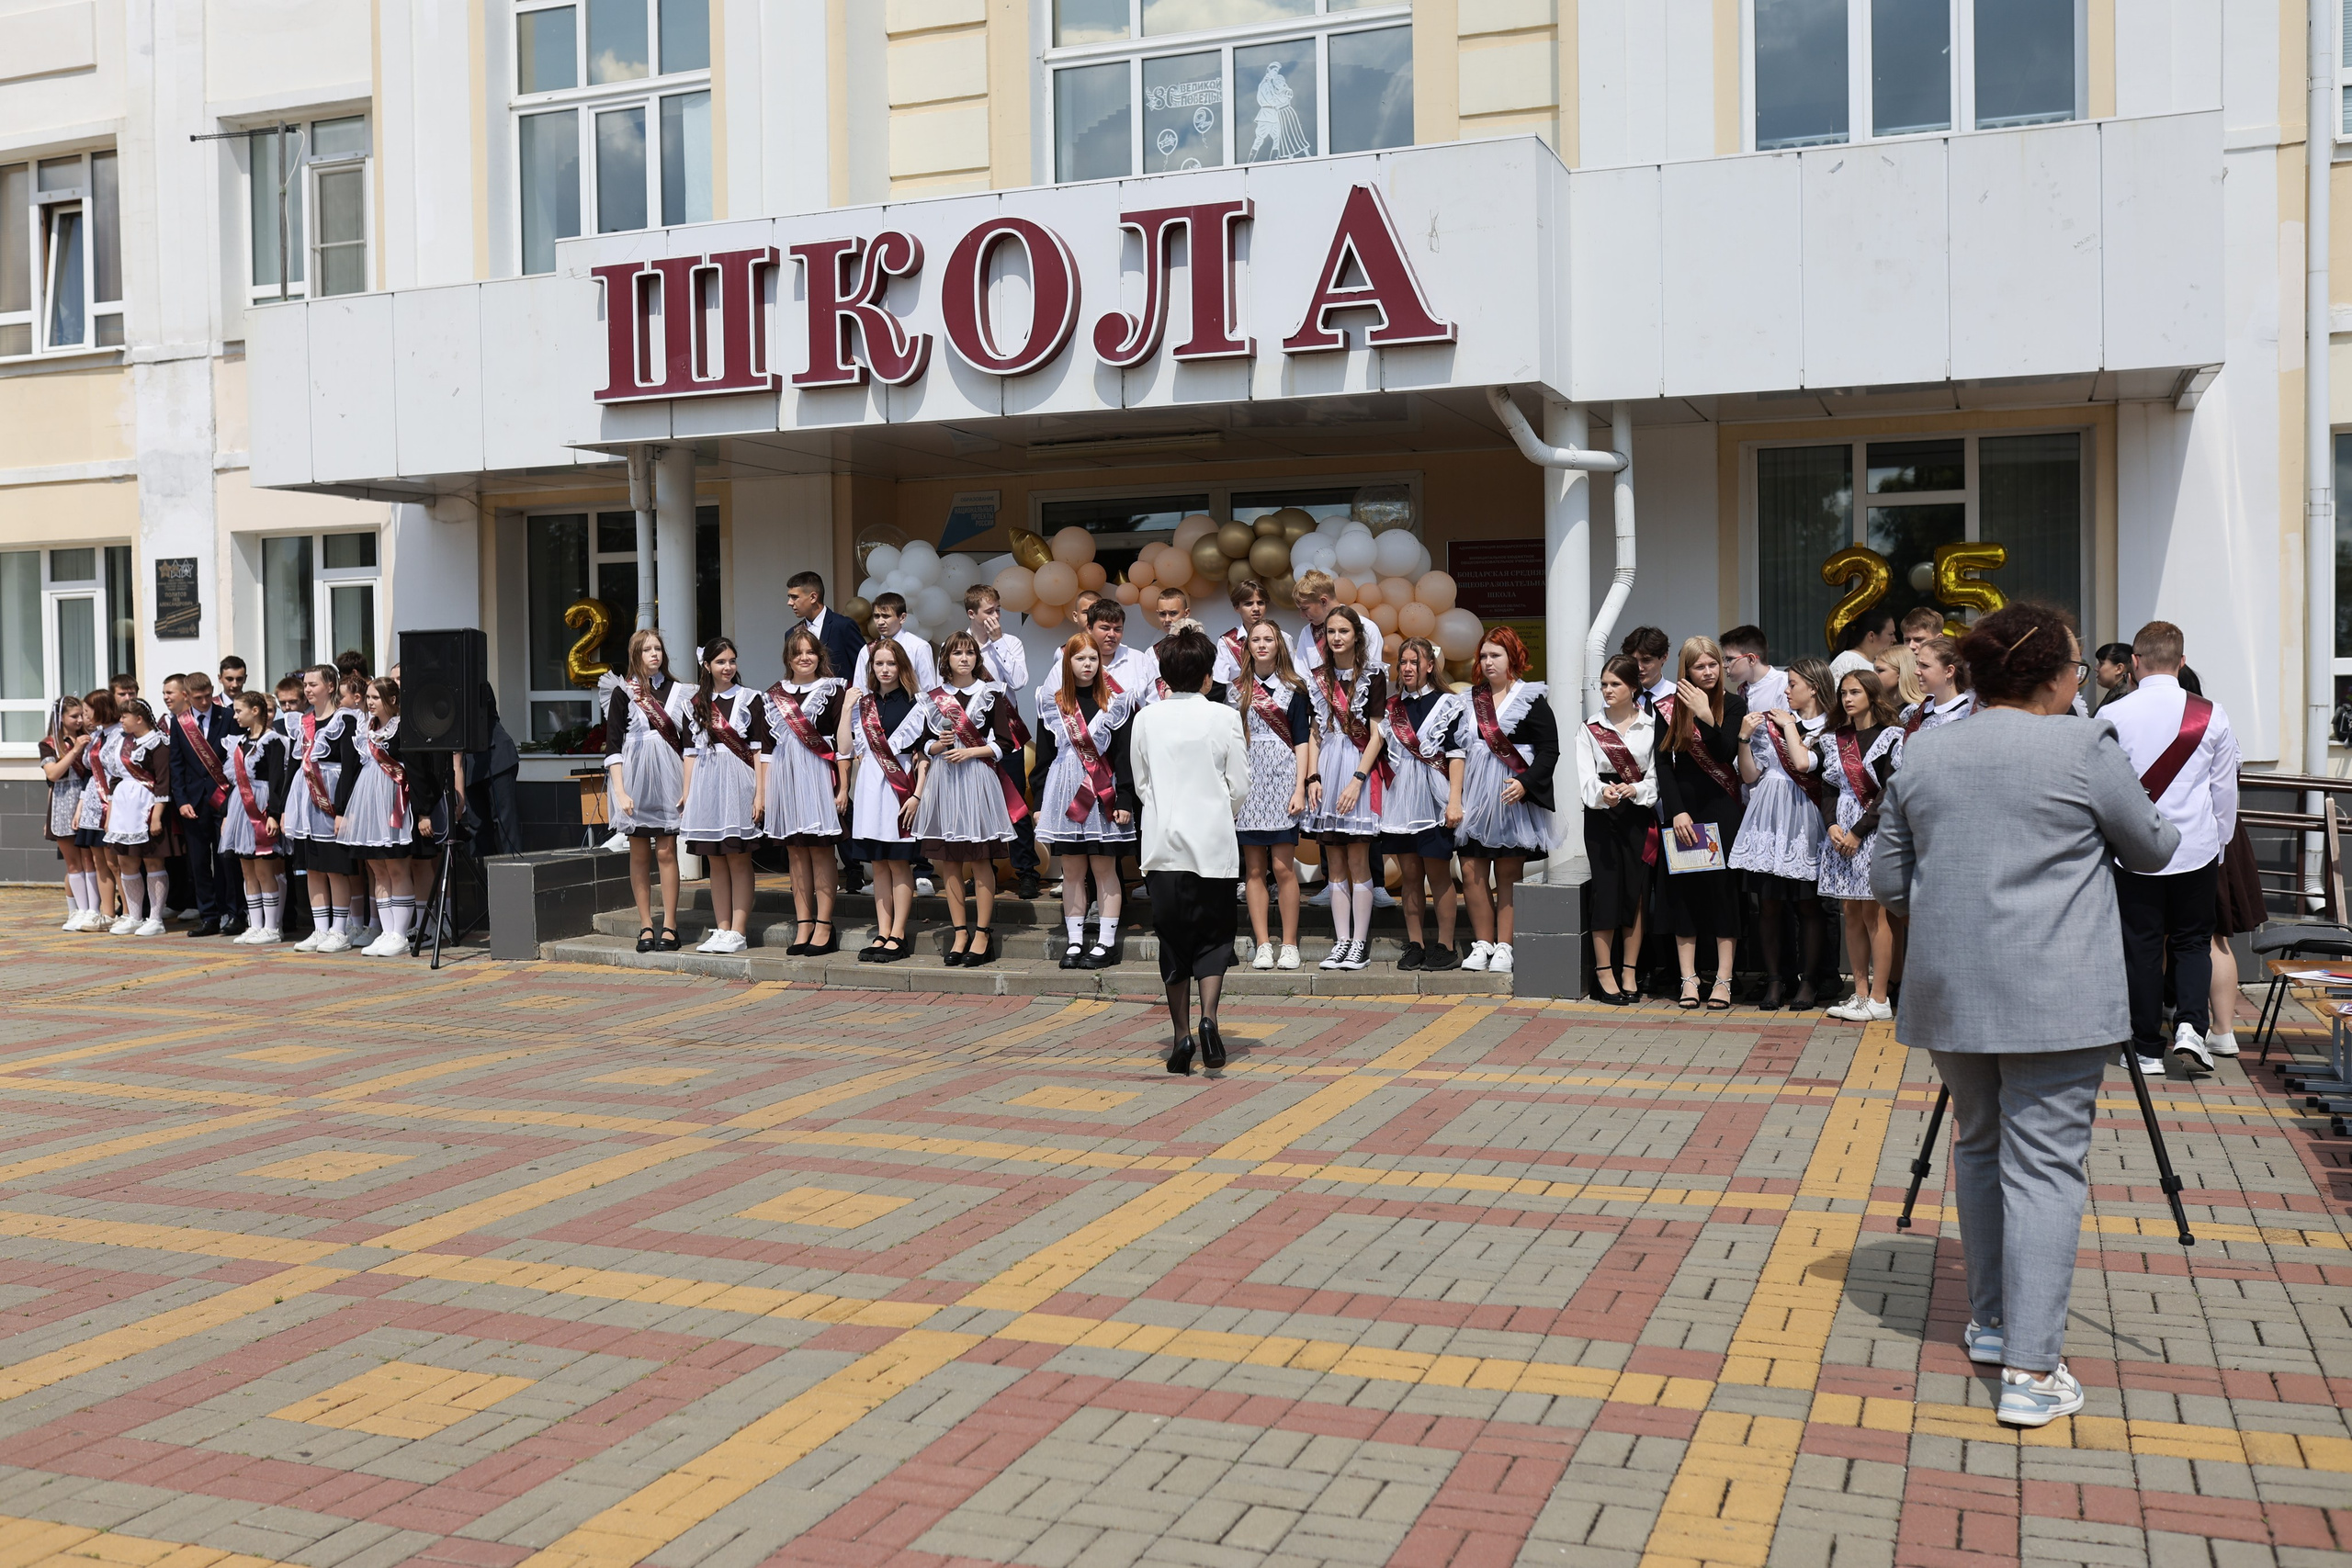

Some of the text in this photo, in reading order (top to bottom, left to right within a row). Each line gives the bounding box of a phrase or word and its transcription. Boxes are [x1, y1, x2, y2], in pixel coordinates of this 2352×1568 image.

[1181, 78, 1222, 93] ВЕЛИКОЙ
[589, 181, 1458, 406] ШКОЛА
[955, 506, 994, 514] НАЦИОНАЛЬНЫЕ
[1457, 570, 1510, 579] БОНДАРСКАЯ
[1457, 580, 1545, 589] БЩЕОБРАЗОВАТЕЛЬНА
